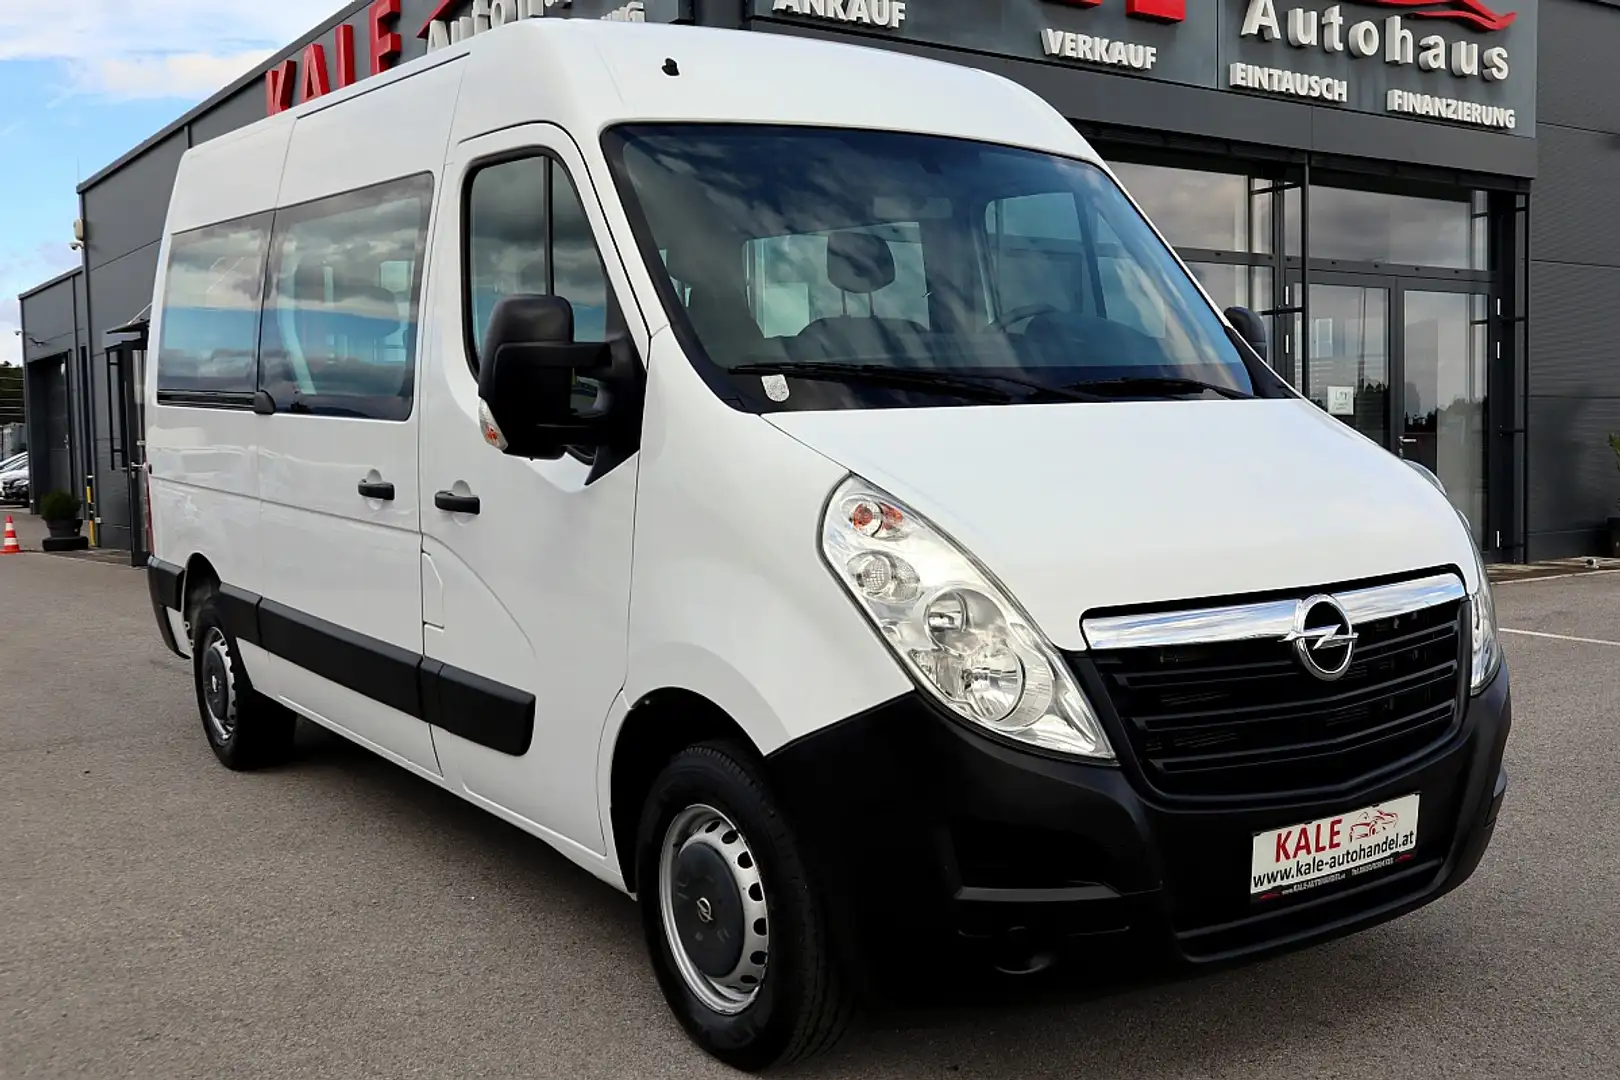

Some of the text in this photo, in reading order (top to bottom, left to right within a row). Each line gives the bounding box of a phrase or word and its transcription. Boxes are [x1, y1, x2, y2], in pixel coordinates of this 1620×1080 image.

[772, 0, 905, 28] ANKAUF
[1041, 28, 1157, 70] VERKAUF
[1241, 0, 1509, 80] Autohaus
[1230, 62, 1347, 102] EINTAUSCH
[1387, 89, 1515, 129] FINANZIERUNG
[1253, 830, 1414, 888] www.kale-autohandel.at
[1275, 818, 1344, 863] KALE
